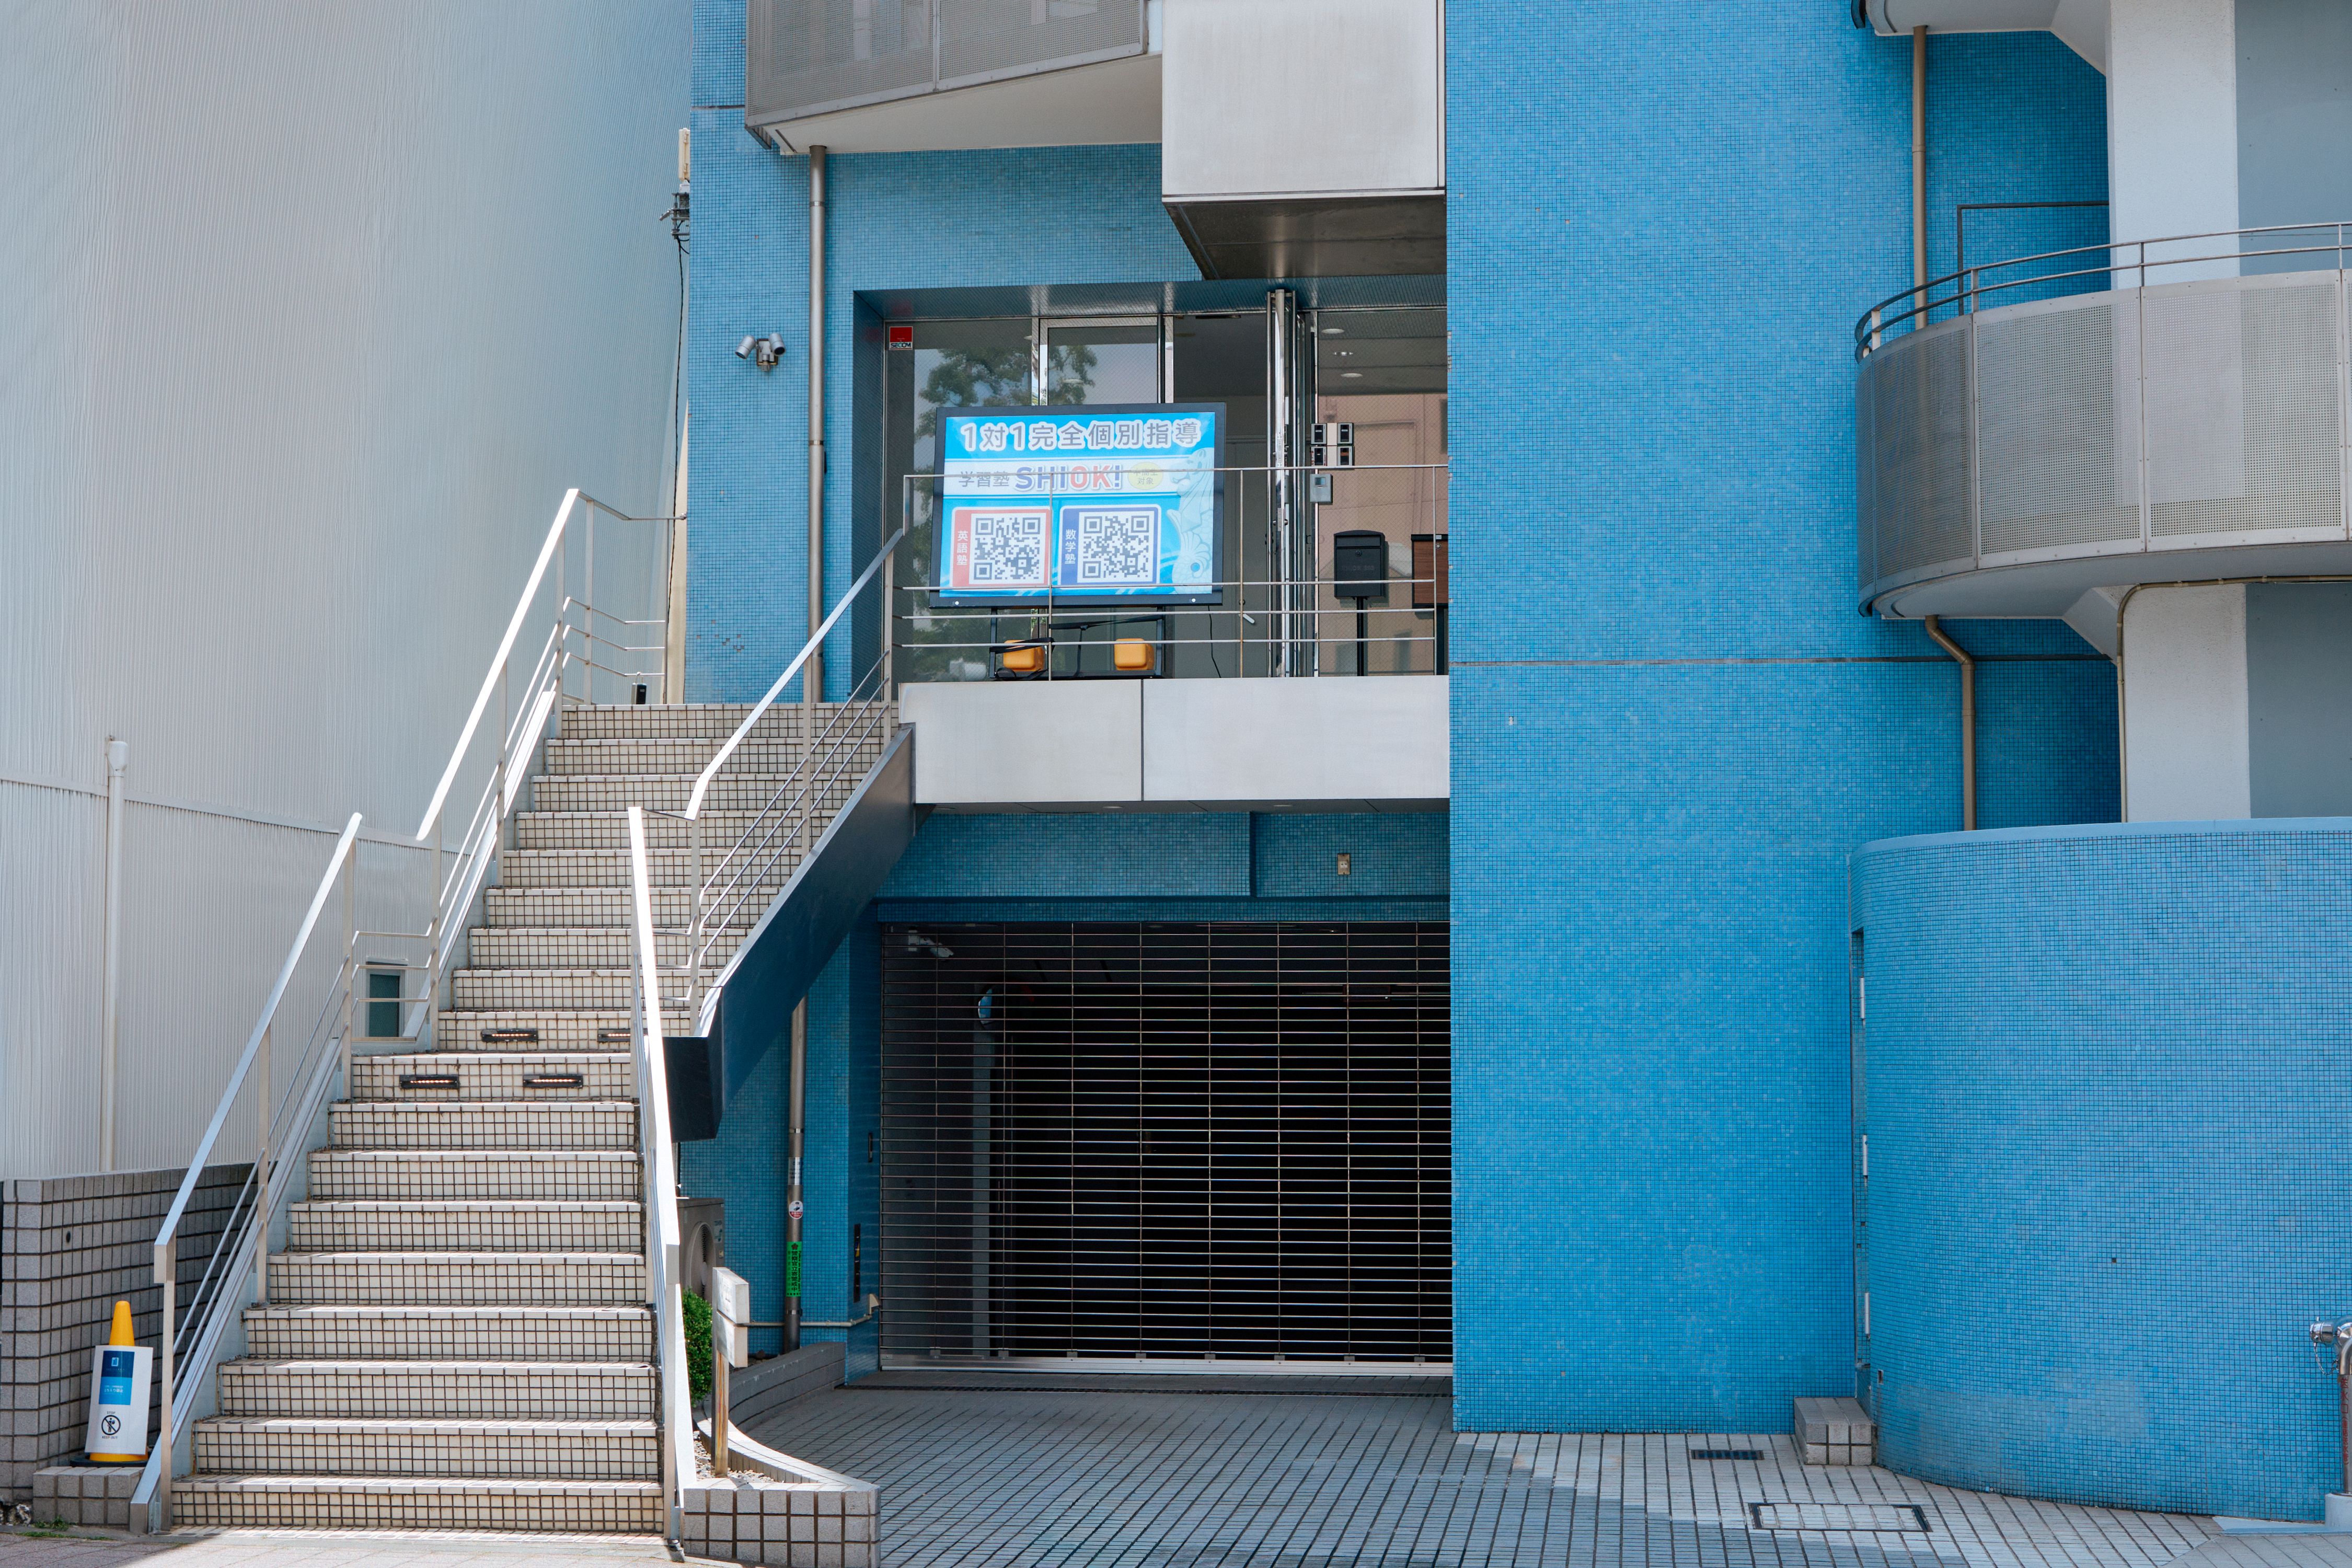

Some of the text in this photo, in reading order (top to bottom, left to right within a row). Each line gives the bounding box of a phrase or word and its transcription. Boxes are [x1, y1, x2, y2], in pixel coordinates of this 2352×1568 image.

[963, 421, 1200, 449] 1対1完全個別指導
[958, 465, 1121, 490] 学習塾 SHIOK!
[956, 531, 969, 566] 英語塾
[1065, 529, 1076, 564] 数学塾
